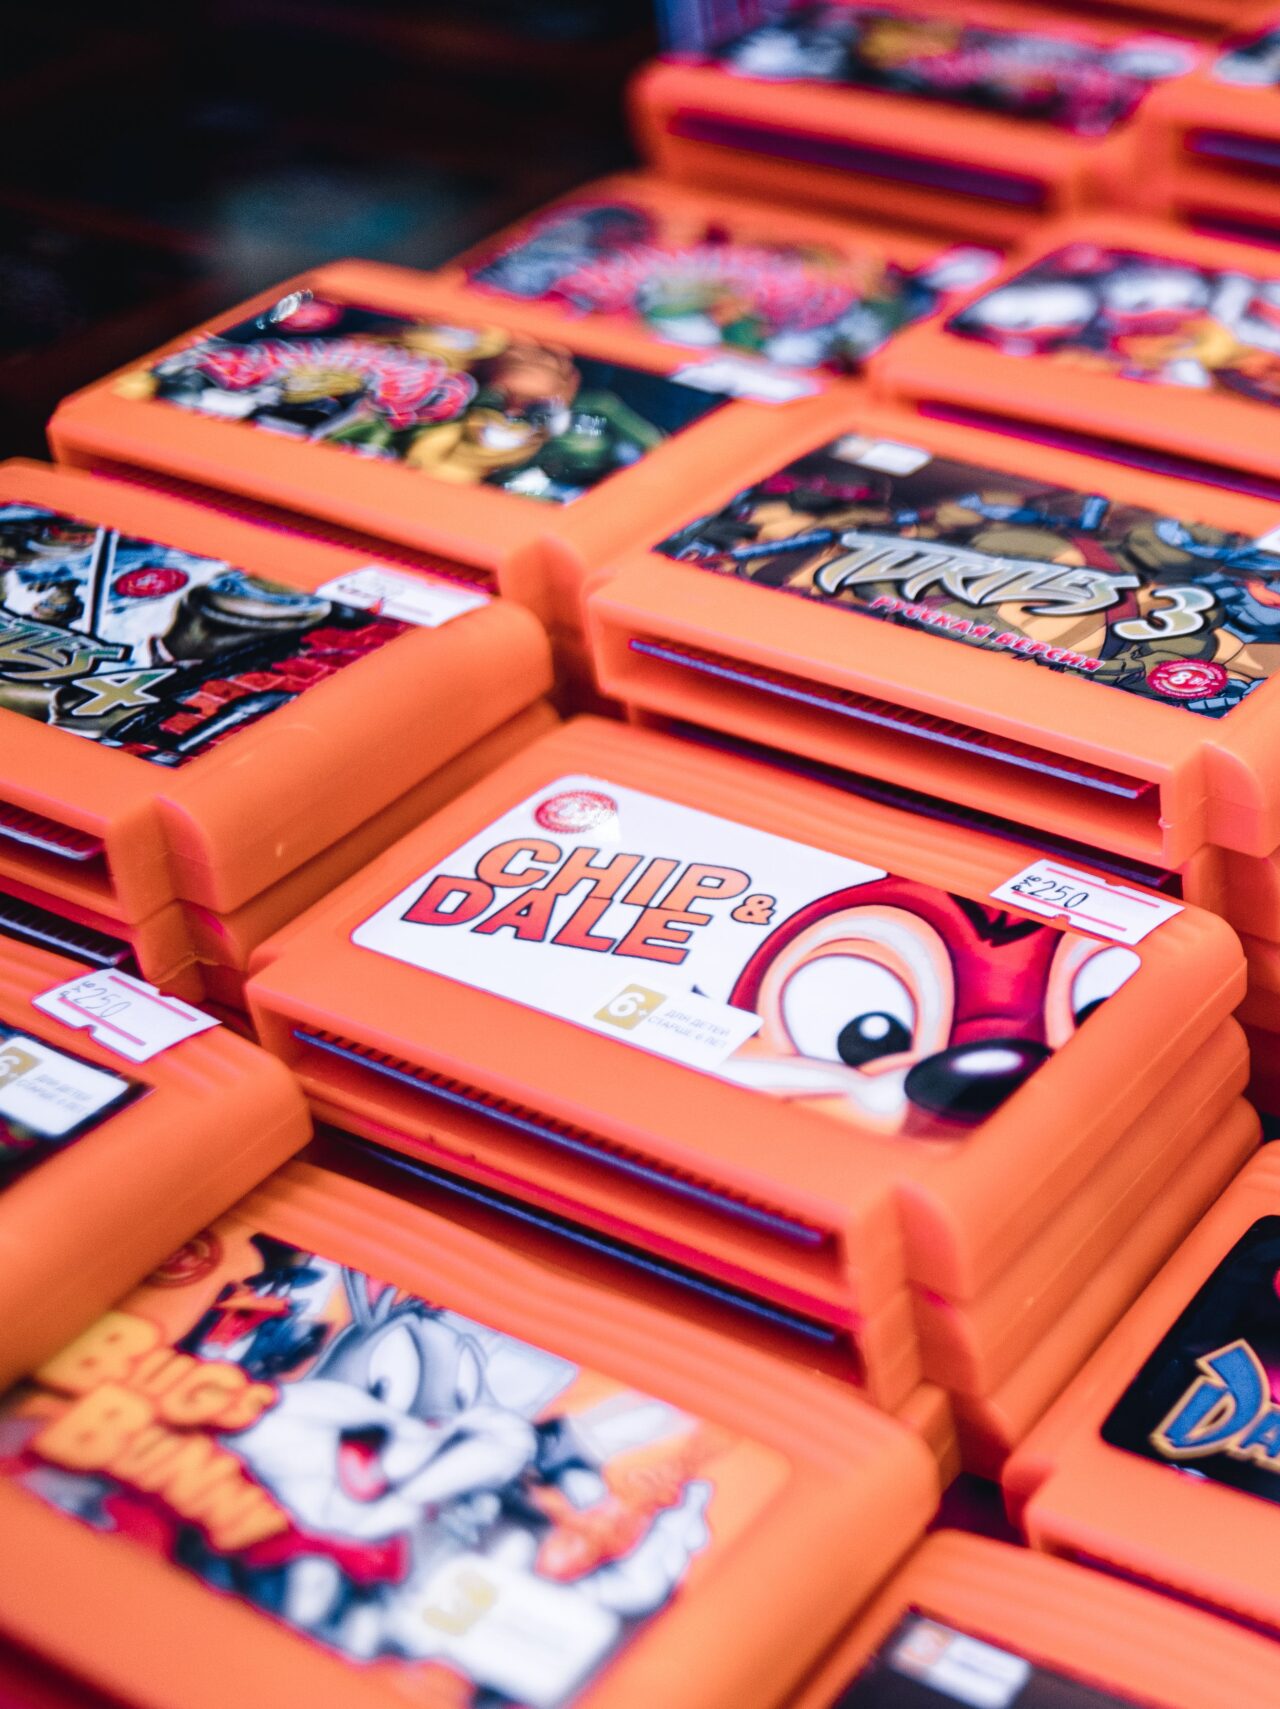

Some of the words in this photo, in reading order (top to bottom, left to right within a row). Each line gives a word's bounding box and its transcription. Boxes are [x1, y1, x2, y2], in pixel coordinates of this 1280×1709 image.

[814, 532, 1141, 616] TURTLES
[1113, 587, 1216, 641] 3
[869, 596, 996, 640] РУССКАЯ
[995, 631, 1107, 673] ВЕРСИЯ
[71, 668, 178, 717] 4
[400, 873, 714, 966] DALE
[475, 837, 752, 913] CHIP
[730, 893, 777, 926] &
[1030, 880, 1090, 909] 250
[74, 987, 132, 1019] 250
